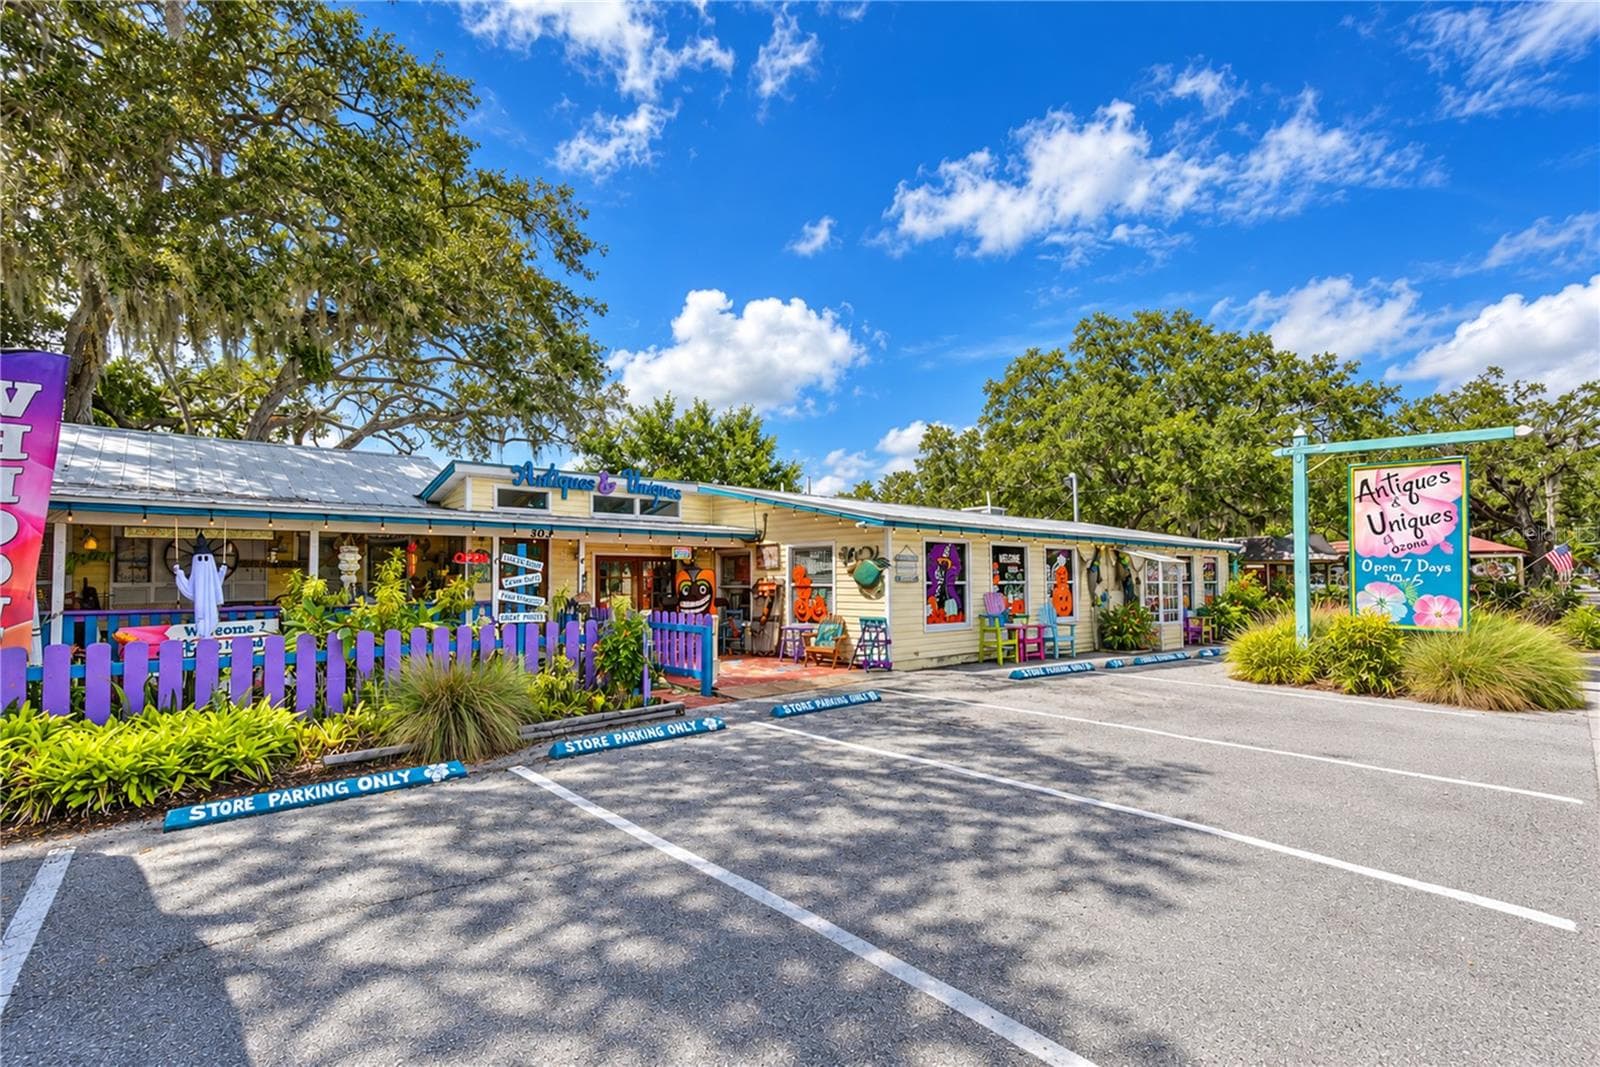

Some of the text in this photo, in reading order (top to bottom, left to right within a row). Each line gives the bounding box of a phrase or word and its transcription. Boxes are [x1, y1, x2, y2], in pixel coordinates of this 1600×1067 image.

[511, 461, 682, 508] Antiques & Uniques
[1354, 471, 1451, 505] Antiques
[1391, 495, 1401, 508] &
[1366, 510, 1454, 539] Uniques
[453, 552, 490, 564] OPEN
[1361, 559, 1452, 577] Open 7 Days
[184, 624, 254, 637] Wcome
[782, 701, 814, 714] STORE
[815, 695, 848, 708] PARKING
[565, 721, 697, 753] STORE PARKING ONLY
[189, 770, 411, 821] STORE PARKING ONLY
